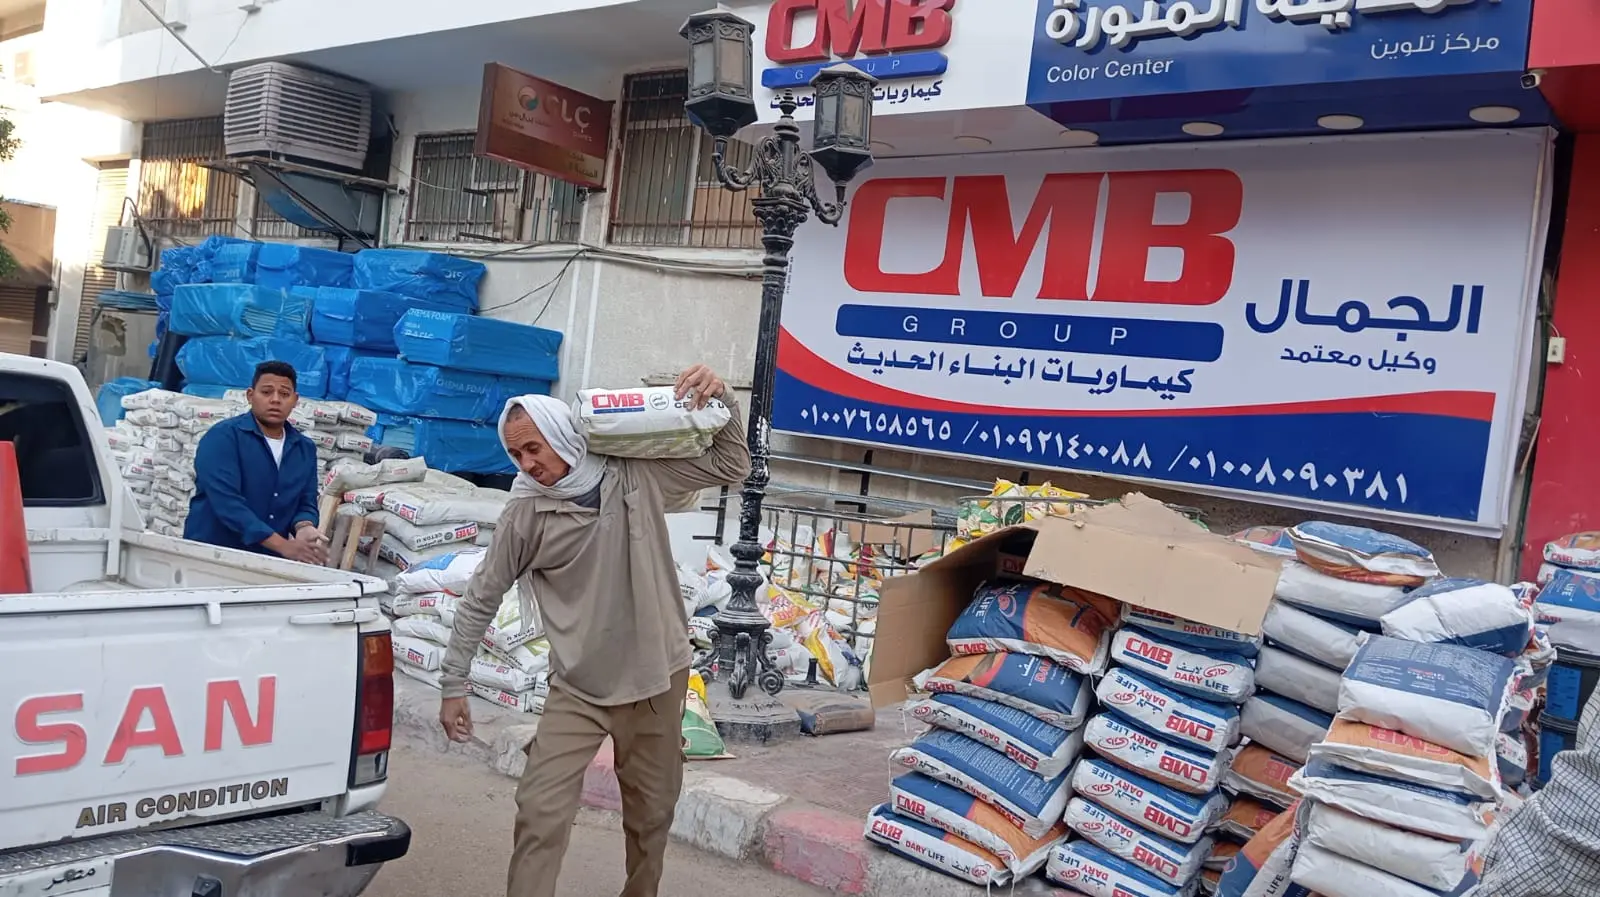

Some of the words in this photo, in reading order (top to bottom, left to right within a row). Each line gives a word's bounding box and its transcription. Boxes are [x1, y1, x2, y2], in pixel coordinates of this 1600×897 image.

[765, 0, 955, 64] CMB
[1441, 32, 1500, 55] مركز
[1370, 34, 1435, 59] تلوين
[795, 60, 900, 80] GUP
[1046, 65, 1099, 83] Color
[1104, 59, 1173, 78] Center
[843, 168, 1243, 306] CMB
[1245, 278, 1485, 342] الجمال
[902, 314, 1128, 346] GROUP
[846, 341, 944, 375] الحديث
[1280, 344, 1362, 367] معتمد
[1368, 349, 1437, 374] وكيل
[948, 352, 1036, 385] البناء
[1041, 360, 1195, 401] كيماويات
[591, 393, 645, 409] CMB
[674, 401, 714, 409] CEX
[1183, 624, 1212, 634] DARY
[1215, 630, 1241, 641] LIFE
[1125, 637, 1174, 665] CMB
[1114, 676, 1138, 692] LIFE
[1174, 671, 1204, 685] DARY
[1205, 680, 1229, 692] LIFE
[1138, 690, 1167, 706] DARY
[14, 675, 277, 776] SAN
[1105, 720, 1130, 736] LIFE
[1165, 714, 1214, 742] CMB
[1130, 733, 1159, 750] DARY
[1091, 766, 1114, 783] LIFE
[1158, 755, 1208, 785] CMB
[1115, 779, 1144, 798] DARY
[76, 802, 127, 829] AIR
[135, 778, 289, 818] CONDITION
[896, 794, 926, 816] CMB
[1083, 804, 1106, 822] LIFE
[872, 820, 904, 841] CMB
[1106, 818, 1134, 839] DARY
[1143, 805, 1191, 838] CMB
[905, 840, 927, 855] DARY
[927, 848, 946, 863] LIFE
[1058, 852, 1080, 868] LIFE
[1132, 845, 1180, 879] CMB
[1081, 864, 1109, 882] DARY
[1266, 873, 1285, 896] LIFE
